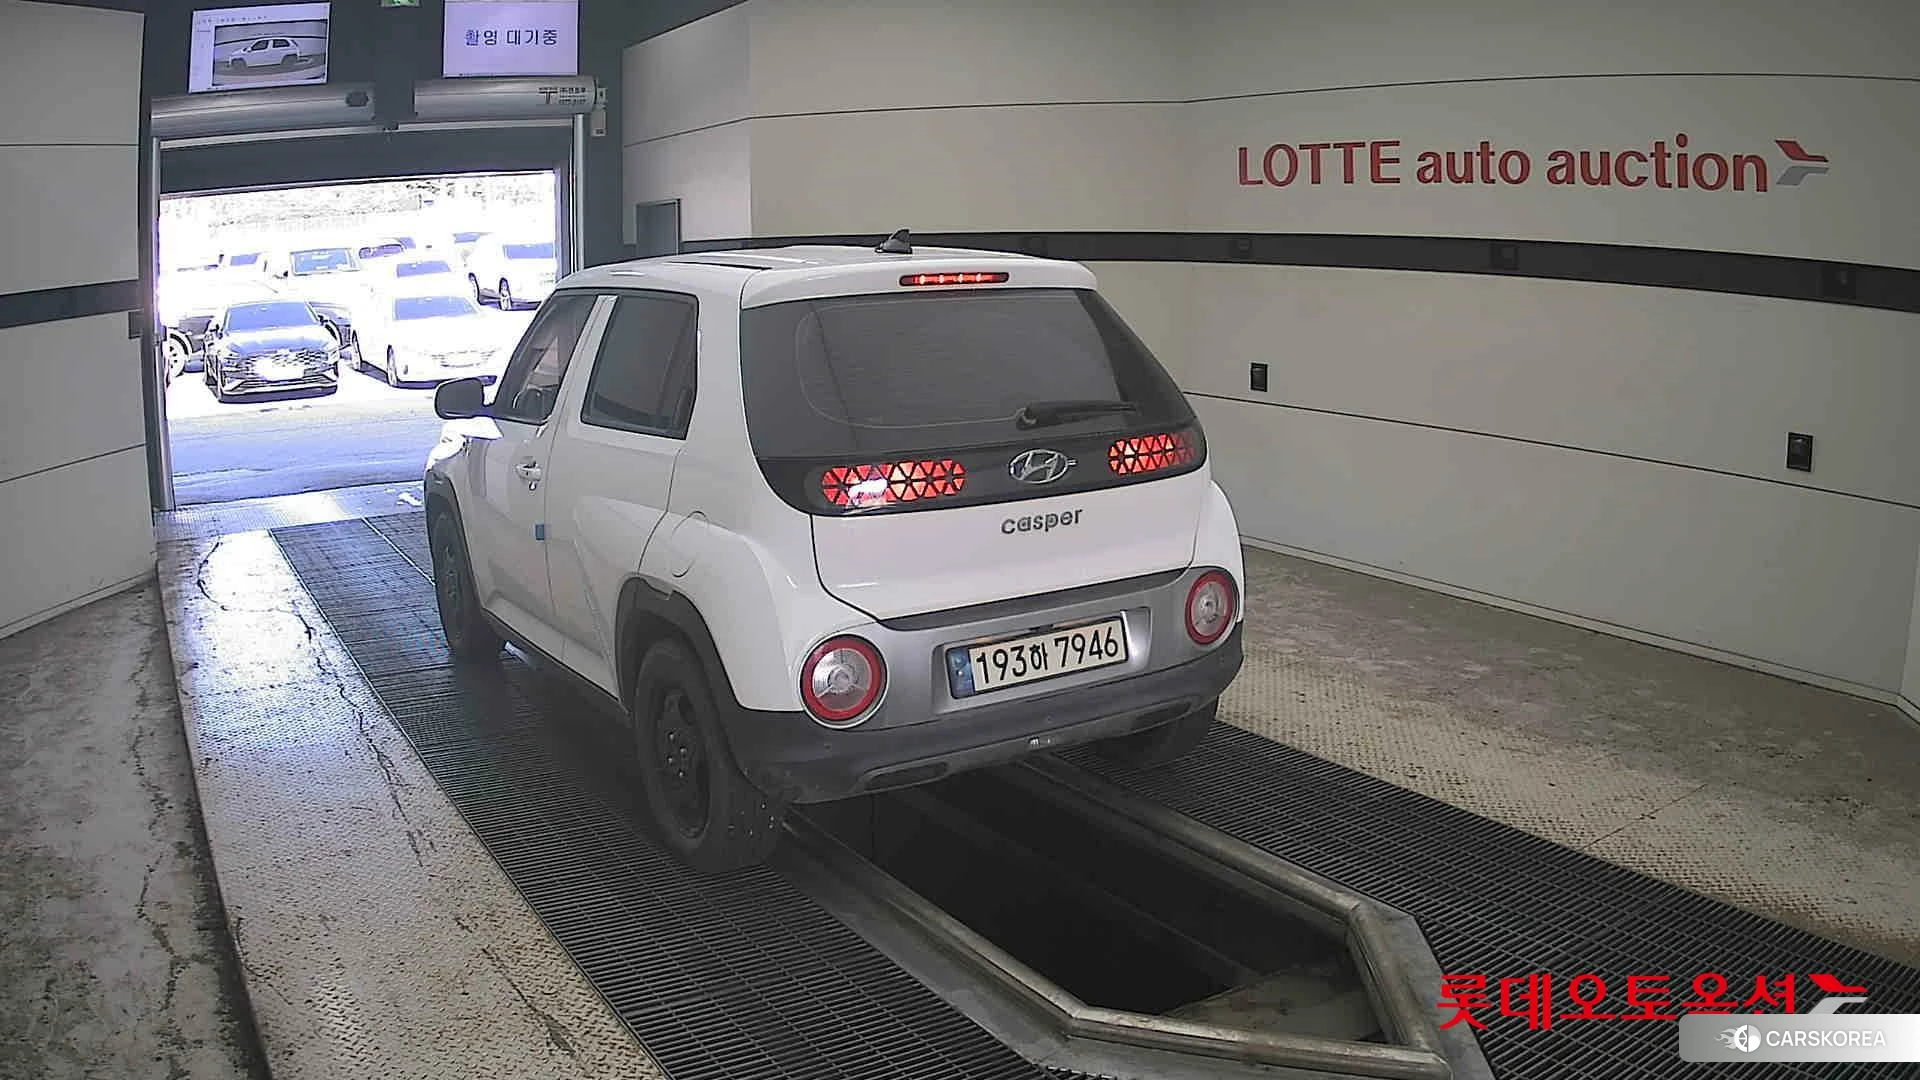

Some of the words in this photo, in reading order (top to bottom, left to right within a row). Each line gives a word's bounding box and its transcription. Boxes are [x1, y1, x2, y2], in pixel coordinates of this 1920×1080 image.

[506, 29, 558, 46] 대기중
[1238, 140, 1400, 186] LOTTE
[1416, 140, 1530, 185] auto
[1546, 133, 1768, 193] auction
[1001, 507, 1083, 535] casper
[1054, 626, 1118, 668] 7946
